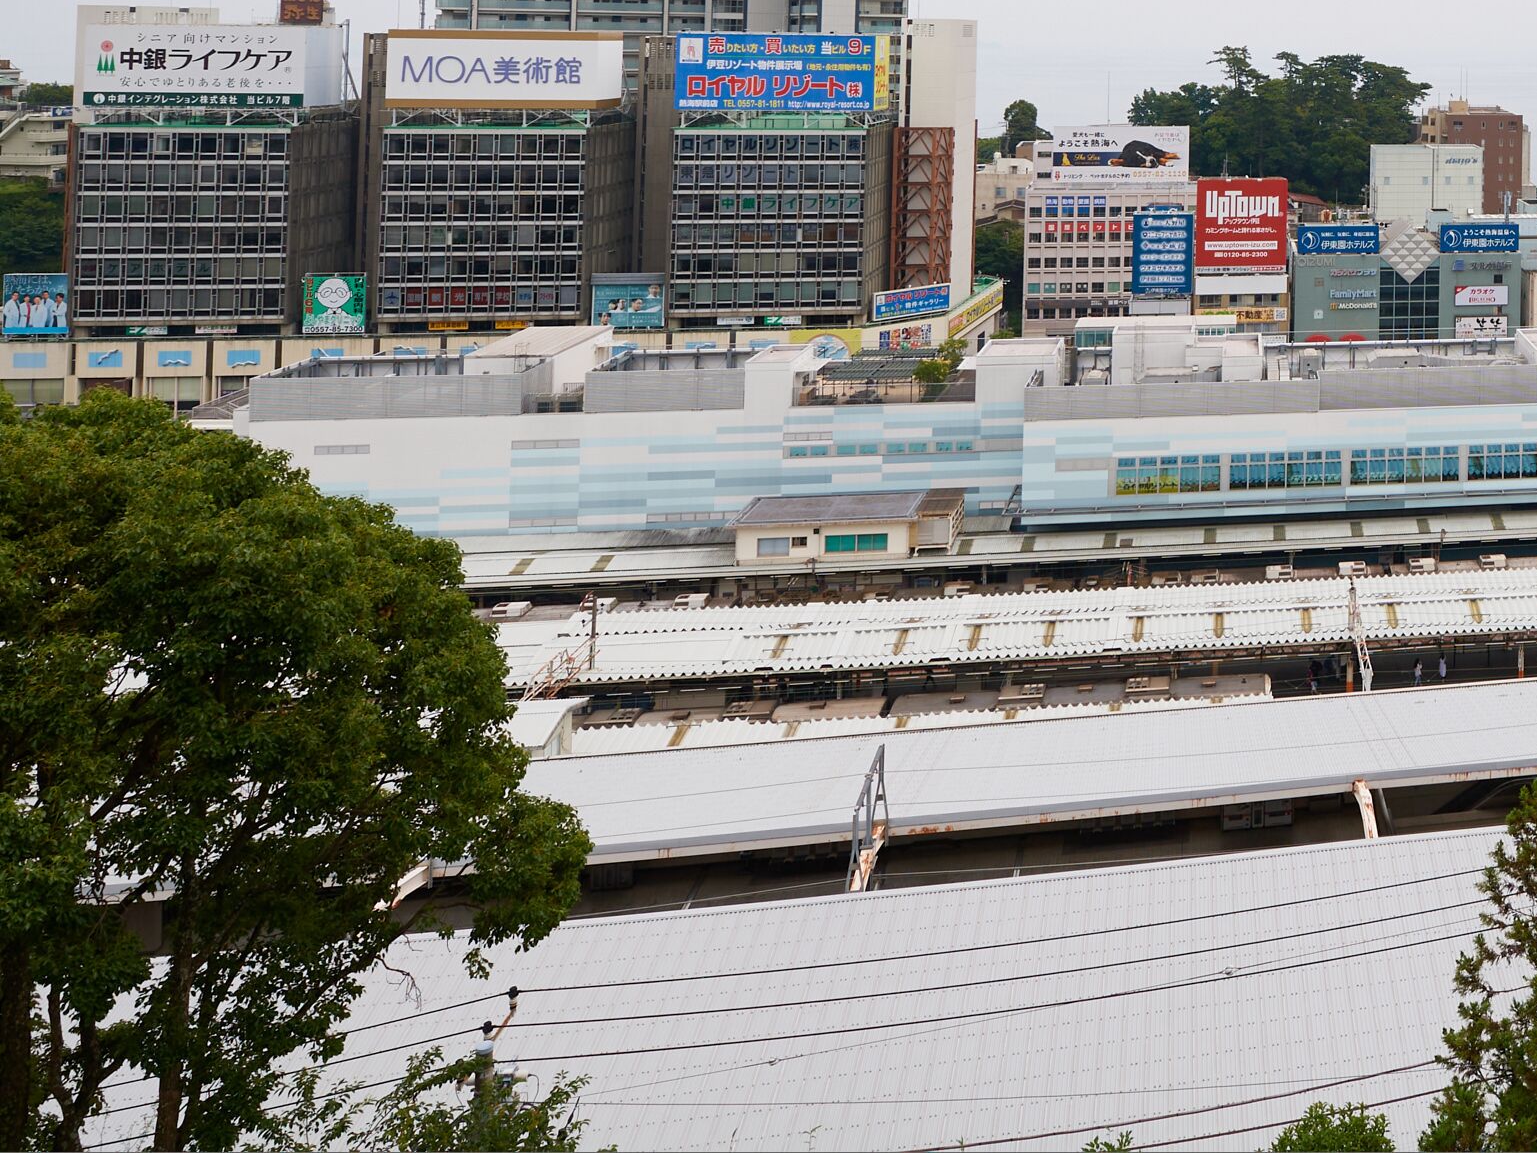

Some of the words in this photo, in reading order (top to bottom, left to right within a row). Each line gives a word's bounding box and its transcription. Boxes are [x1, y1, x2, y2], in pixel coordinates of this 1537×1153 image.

[137, 32, 278, 44] シニア向けマンション
[120, 48, 293, 71] 中銀ライフケア
[401, 55, 582, 84] MOA美術館
[687, 75, 765, 97] ロイヤル
[774, 75, 845, 98] リゾート
[108, 94, 238, 105] 中銀インテグレーション株式会社
[723, 99, 737, 108] TEL
[1058, 139, 1119, 148] ようこそ熱海へ
[1207, 241, 1277, 249] www.uptown-izu.com
[1320, 240, 1376, 250] 伊東園ホテルズ
[1462, 238, 1515, 248] 伊東園ホテルズ
[1297, 257, 1335, 267] OIZUMI
[1329, 289, 1377, 299] FamilyMart
[1236, 310, 1263, 320] 不動産
